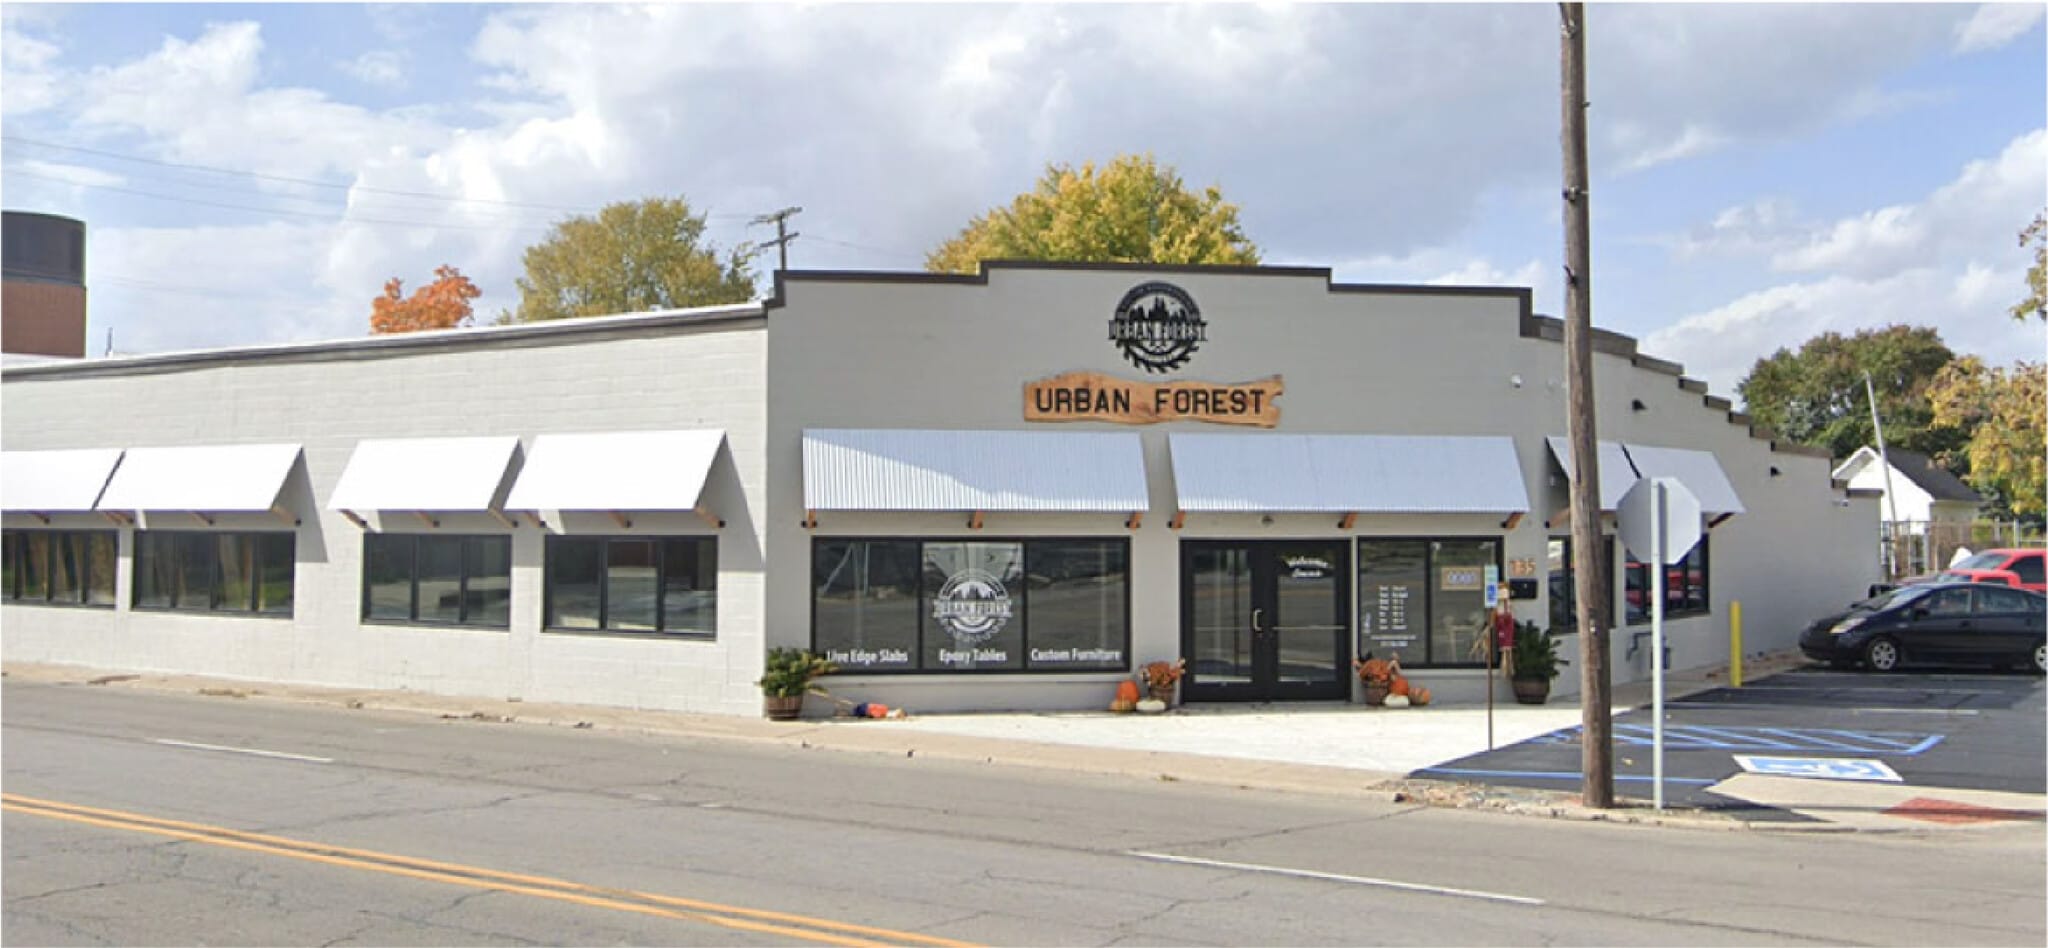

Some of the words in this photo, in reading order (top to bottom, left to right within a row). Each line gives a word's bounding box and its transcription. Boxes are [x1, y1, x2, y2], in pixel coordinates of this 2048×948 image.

[1035, 387, 1130, 413] URBAN
[1154, 388, 1266, 414] FOREST
[850, 648, 877, 665] Edge
[879, 648, 908, 663] Slabs
[940, 648, 970, 665] Epoxy
[973, 648, 1006, 662] Tables
[1031, 647, 1070, 662] Custom
[1071, 647, 1121, 662] Furniture
